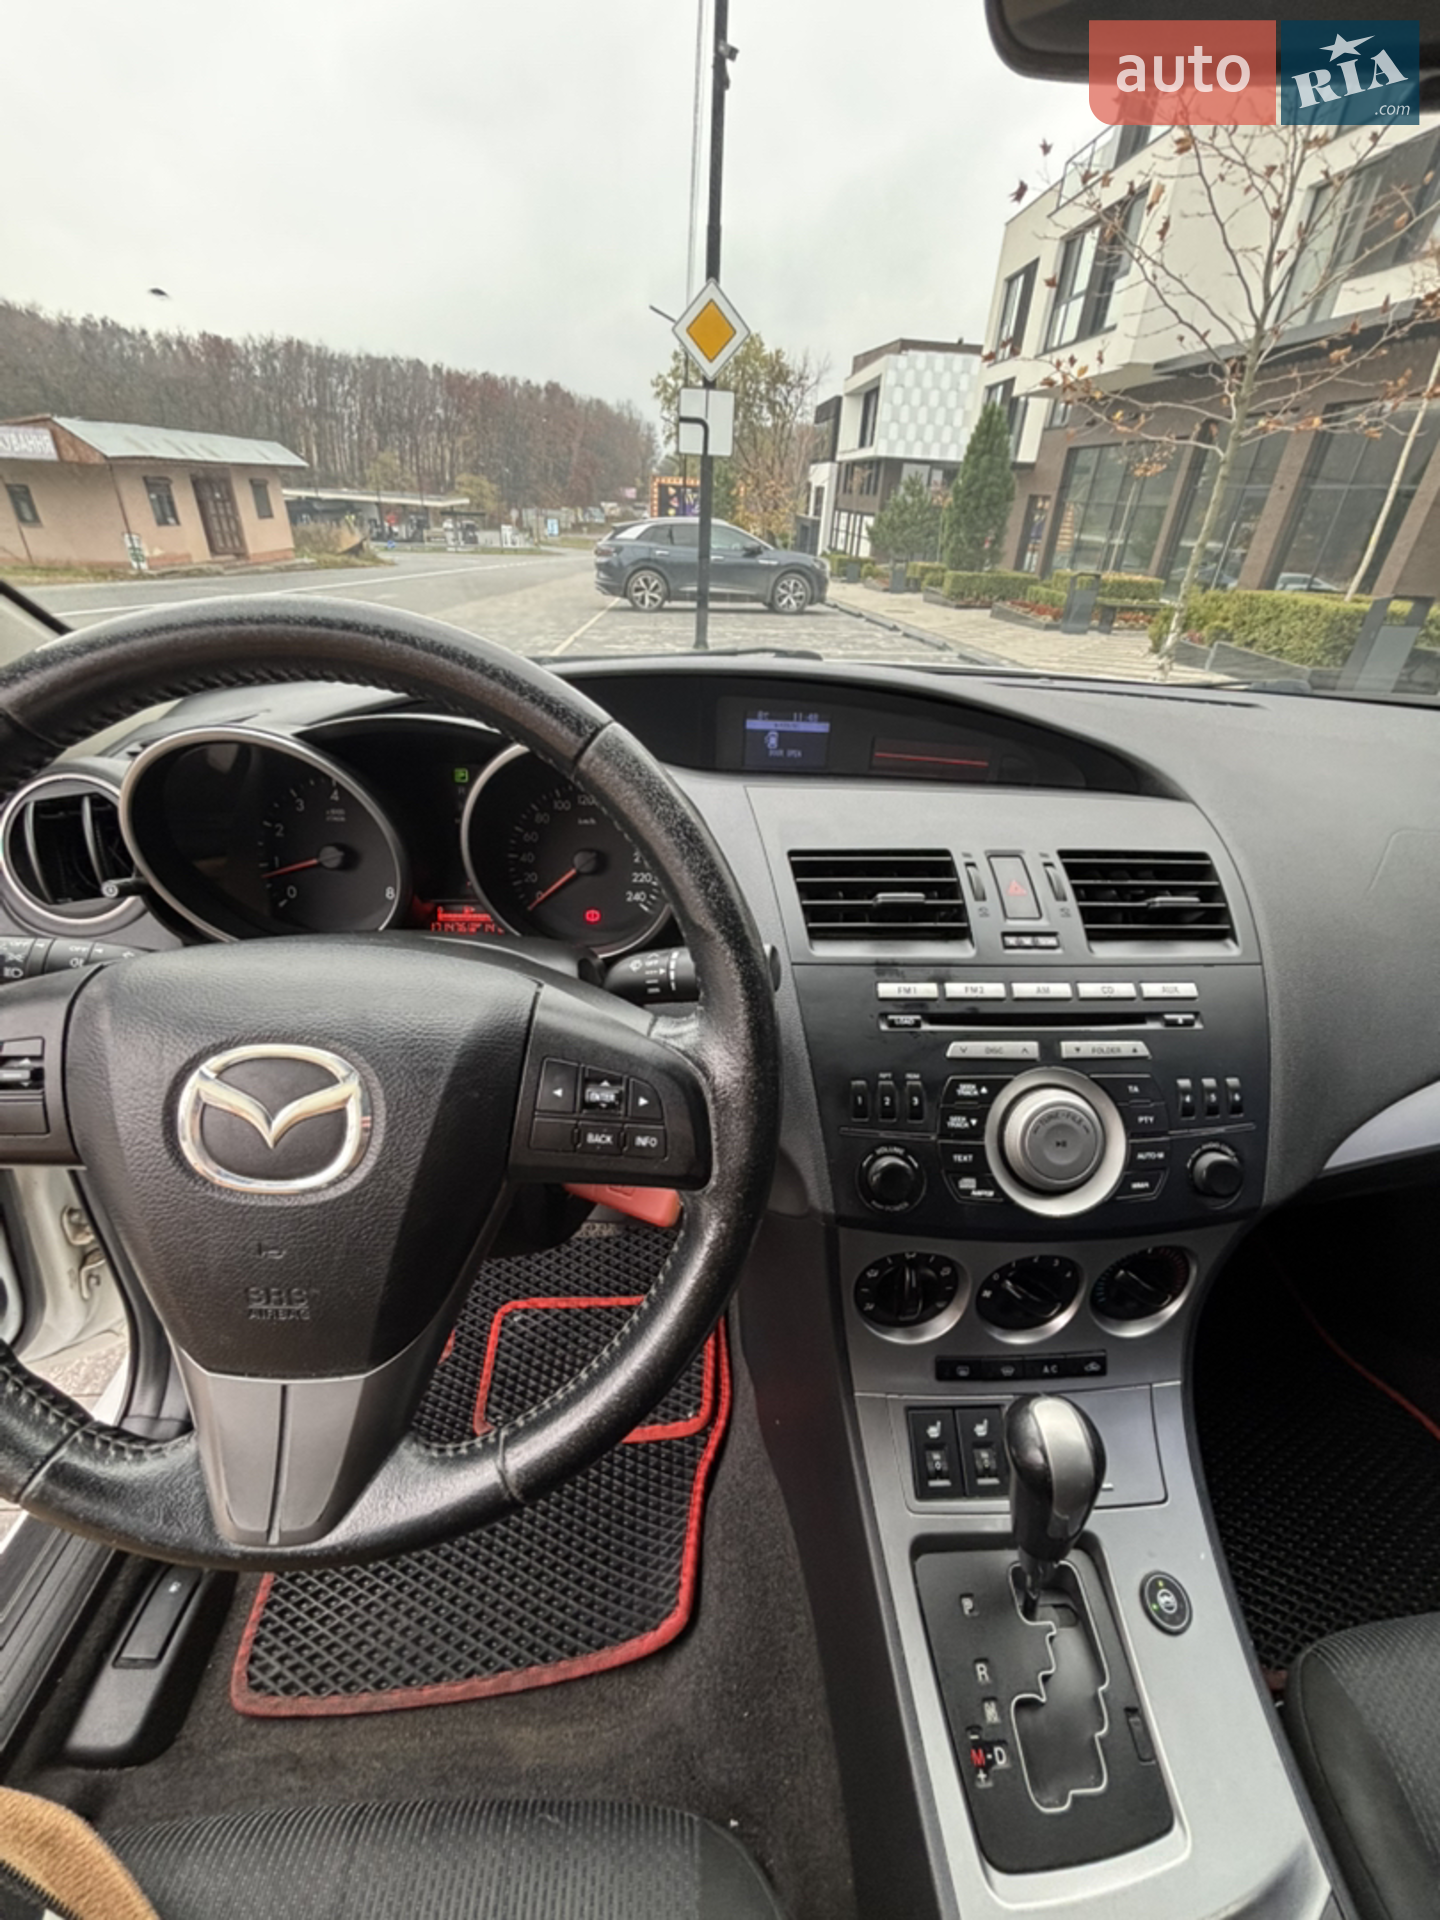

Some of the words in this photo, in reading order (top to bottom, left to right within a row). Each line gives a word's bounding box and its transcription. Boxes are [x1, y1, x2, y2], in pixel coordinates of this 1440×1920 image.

[330, 790, 339, 801] 4
[296, 800, 304, 812] 3
[553, 800, 571, 811] 100
[535, 813, 550, 824] 80
[275, 824, 284, 836] 2
[523, 832, 539, 843] 60
[520, 852, 535, 863] 40
[524, 872, 538, 883] 20
[632, 872, 652, 883] 220
[286, 886, 297, 898] 0
[385, 886, 395, 899] 8
[626, 891, 647, 902] 240
[1101, 986, 1115, 995] CD
[1128, 1085, 1140, 1093] TA
[856, 1096, 862, 1106] 1
[884, 1096, 891, 1106] 2
[912, 1096, 919, 1106] 3
[1184, 1094, 1191, 1103] 4
[1209, 1093, 1217, 1102] 5
[1138, 1115, 1154, 1123] PTY
[586, 1132, 614, 1145] BACK
[634, 1135, 659, 1147] INFO
[953, 1154, 973, 1162] TEXT
[975, 1663, 990, 1682] R
[984, 1701, 999, 1723] N
[970, 1747, 986, 1767] M
[993, 1746, 1007, 1766] D
